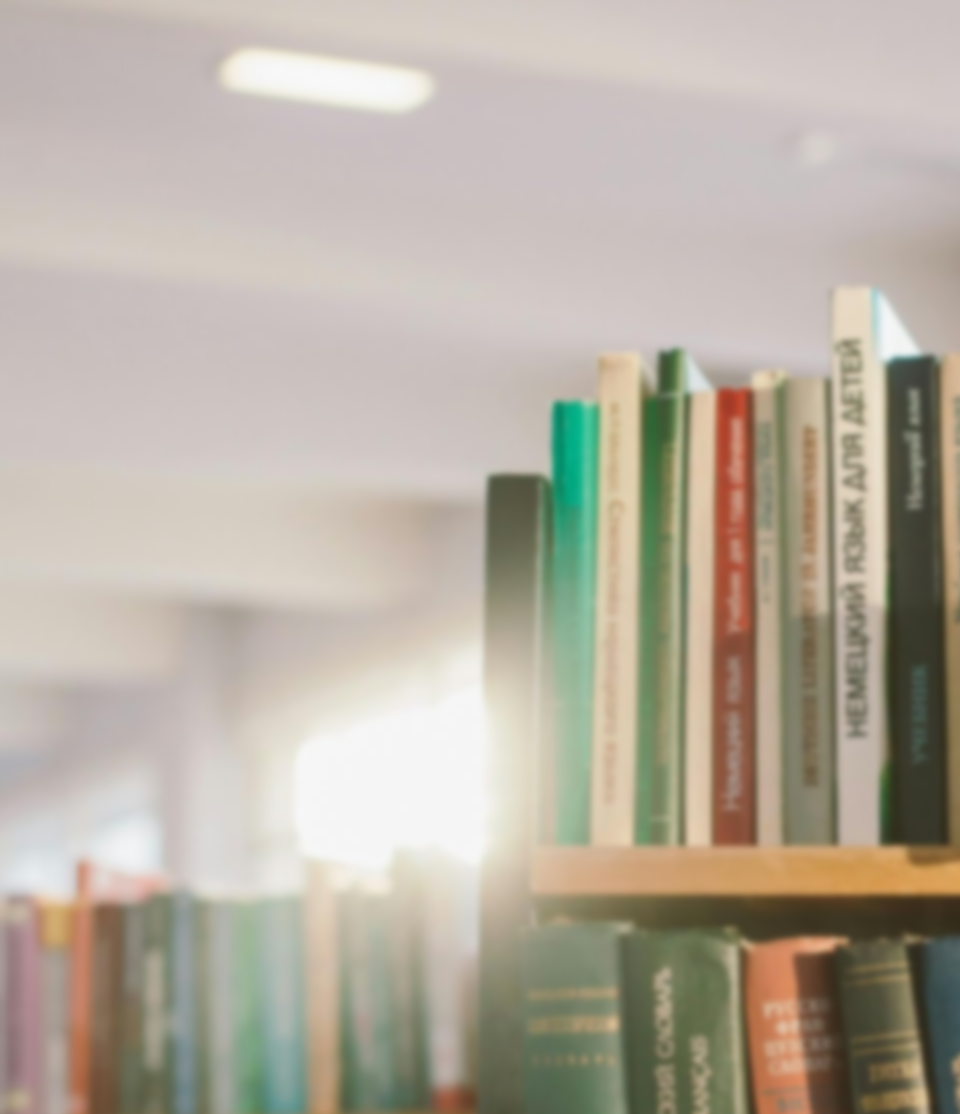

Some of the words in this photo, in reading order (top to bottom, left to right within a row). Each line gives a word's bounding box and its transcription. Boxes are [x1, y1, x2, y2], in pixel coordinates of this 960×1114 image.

[834, 337, 866, 427] ДЕТЕЙ
[907, 387, 922, 427] язык
[727, 416, 743, 485] обучения
[842, 432, 867, 493] ДЛЯ
[902, 431, 926, 512] Немецкий
[729, 489, 744, 528] года
[801, 425, 817, 556] JAHRHUNDERT
[728, 535, 744, 563] для
[843, 498, 866, 575] ЯЗЫК
[725, 571, 744, 635] Учебник
[801, 586, 818, 691] LITERATUR
[723, 655, 741, 704] язык
[840, 582, 870, 739] НЕМЕЦКИЙ
[910, 664, 929, 765] УЧЕБНИК
[721, 710, 743, 811] Немецкий
[653, 966, 677, 1059] СЛОВАРЬ
